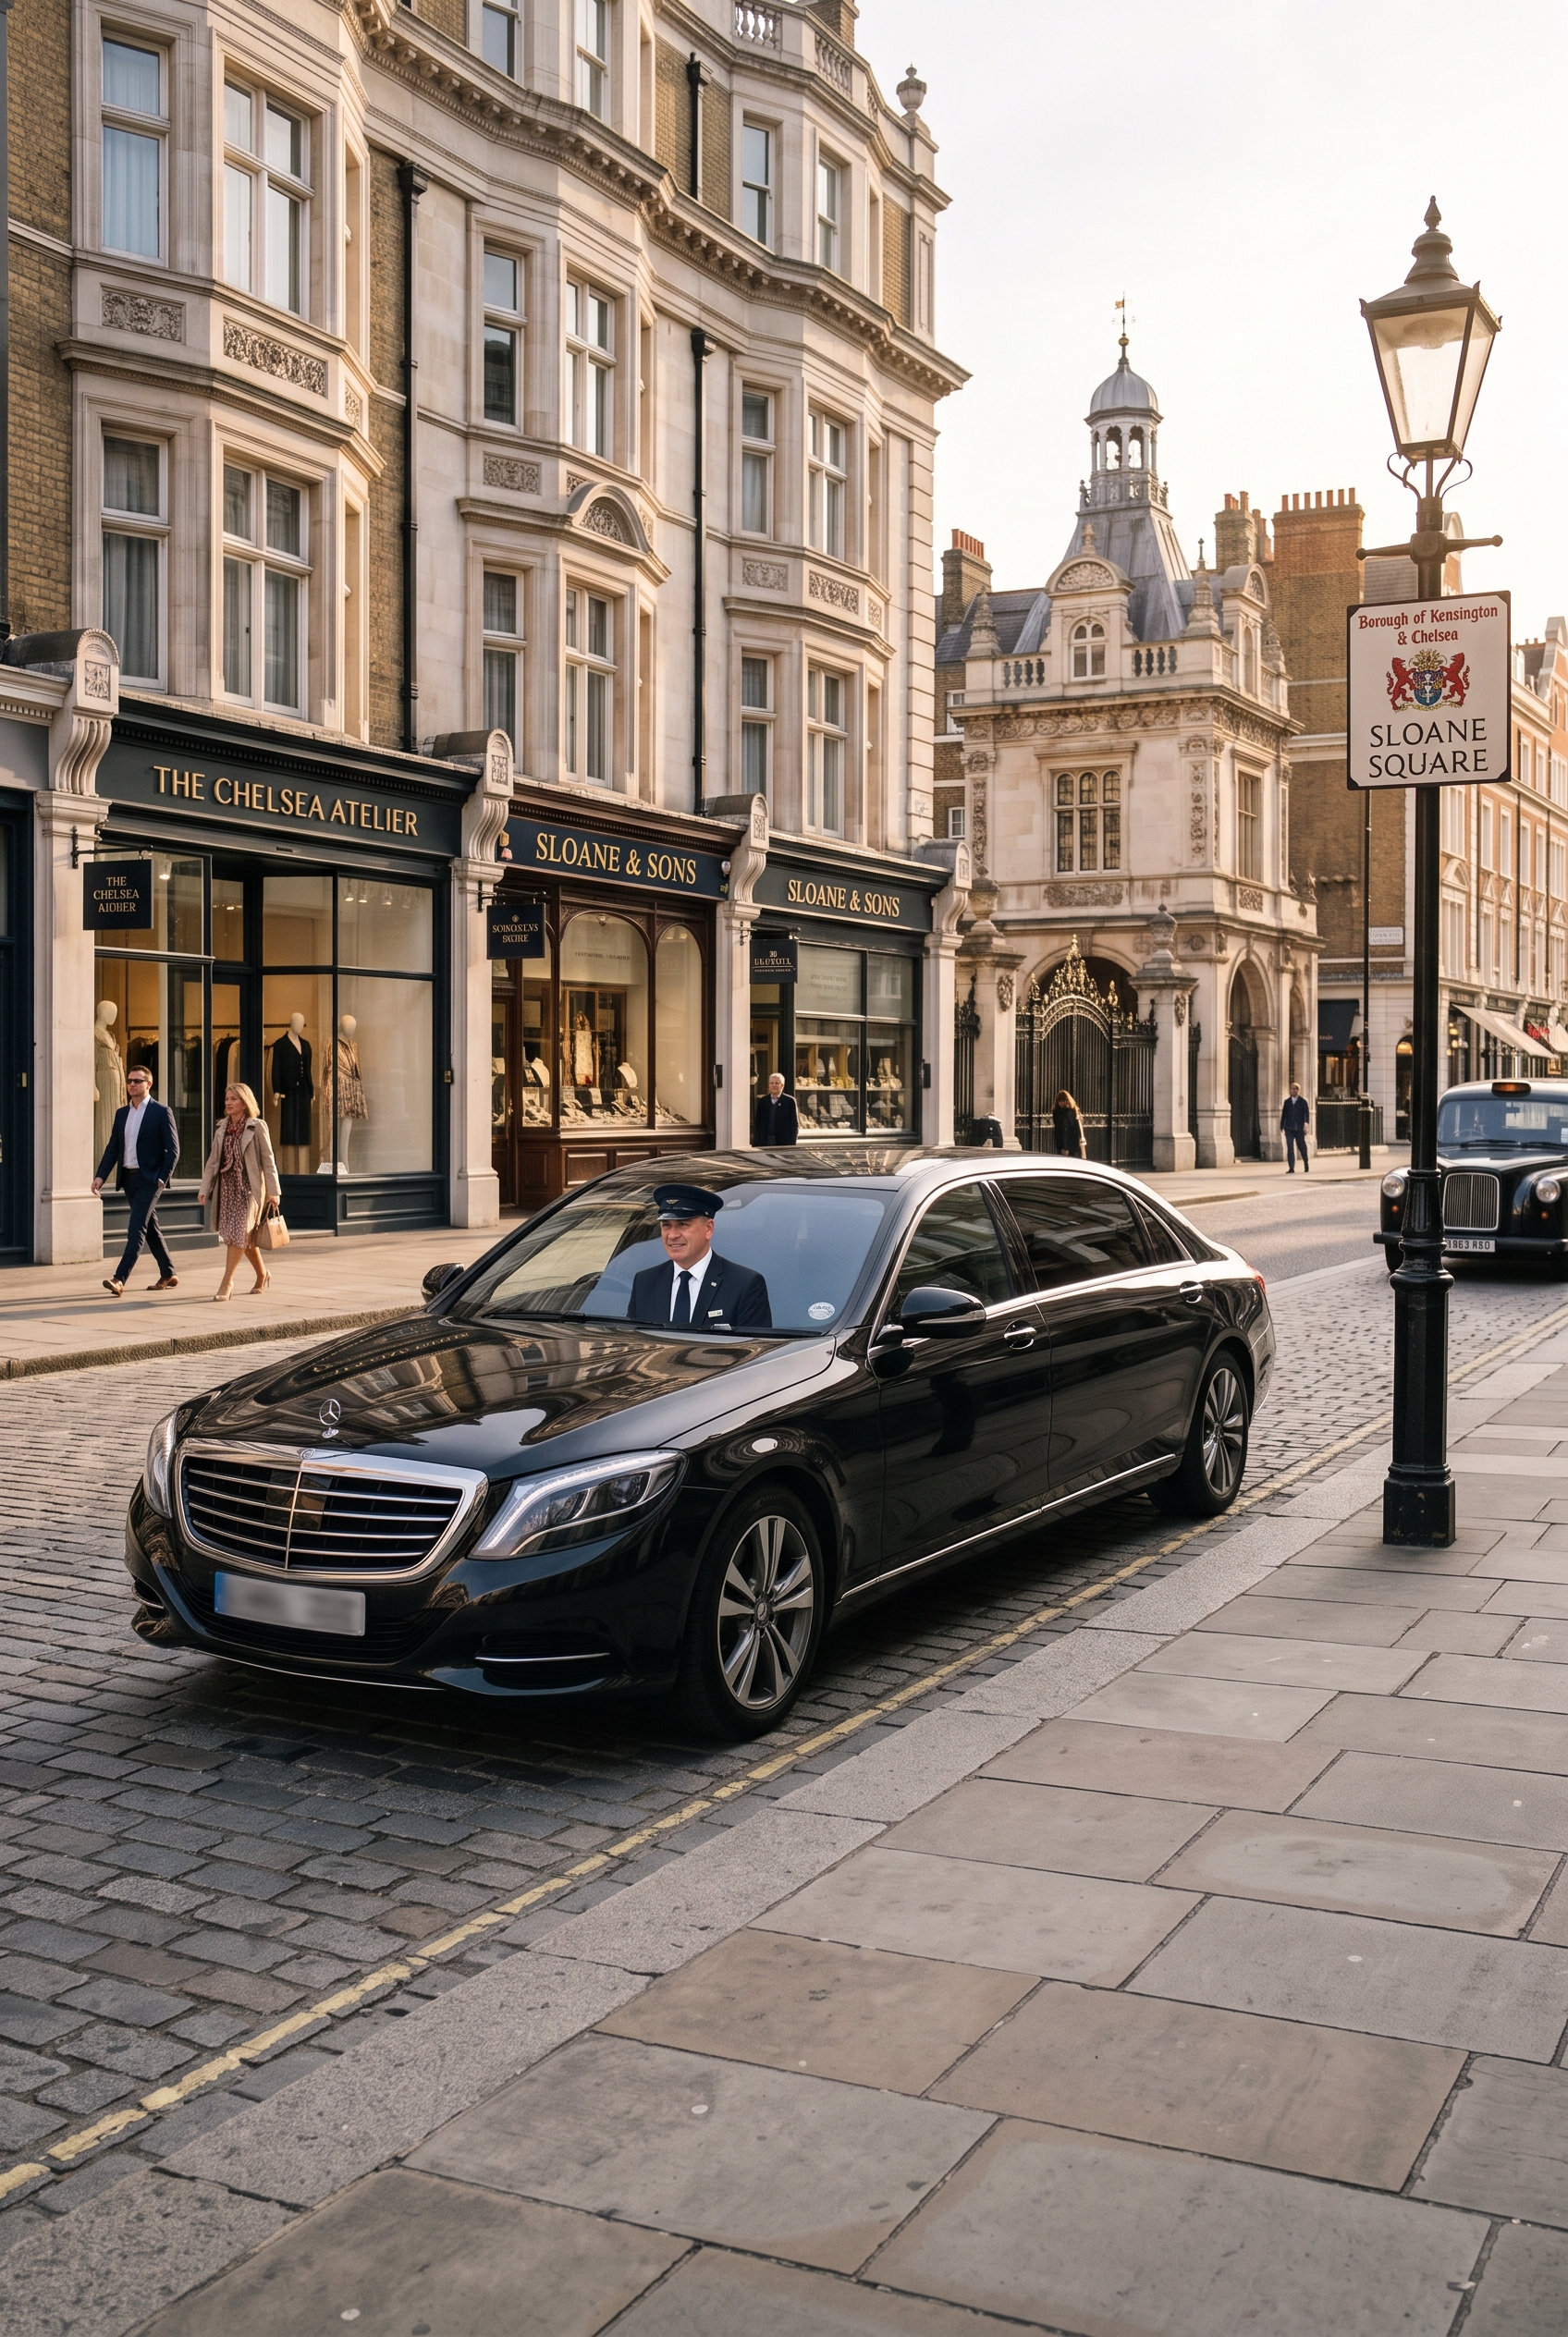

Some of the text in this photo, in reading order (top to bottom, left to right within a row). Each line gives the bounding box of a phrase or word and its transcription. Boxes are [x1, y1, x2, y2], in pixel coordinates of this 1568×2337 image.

[1358, 606, 1498, 630] Borough of Kensington
[1397, 629, 1458, 645] & Chelsea
[1370, 717, 1488, 748] SLOANE
[1368, 749, 1488, 779] SQUARE
[153, 765, 418, 836] THE CHELSEA ATELIER
[535, 832, 697, 885] SLOANE & SONS
[93, 889, 140, 899] CHELSEA
[106, 876, 127, 887] THE
[788, 879, 900, 917] SLOANE & SONS
